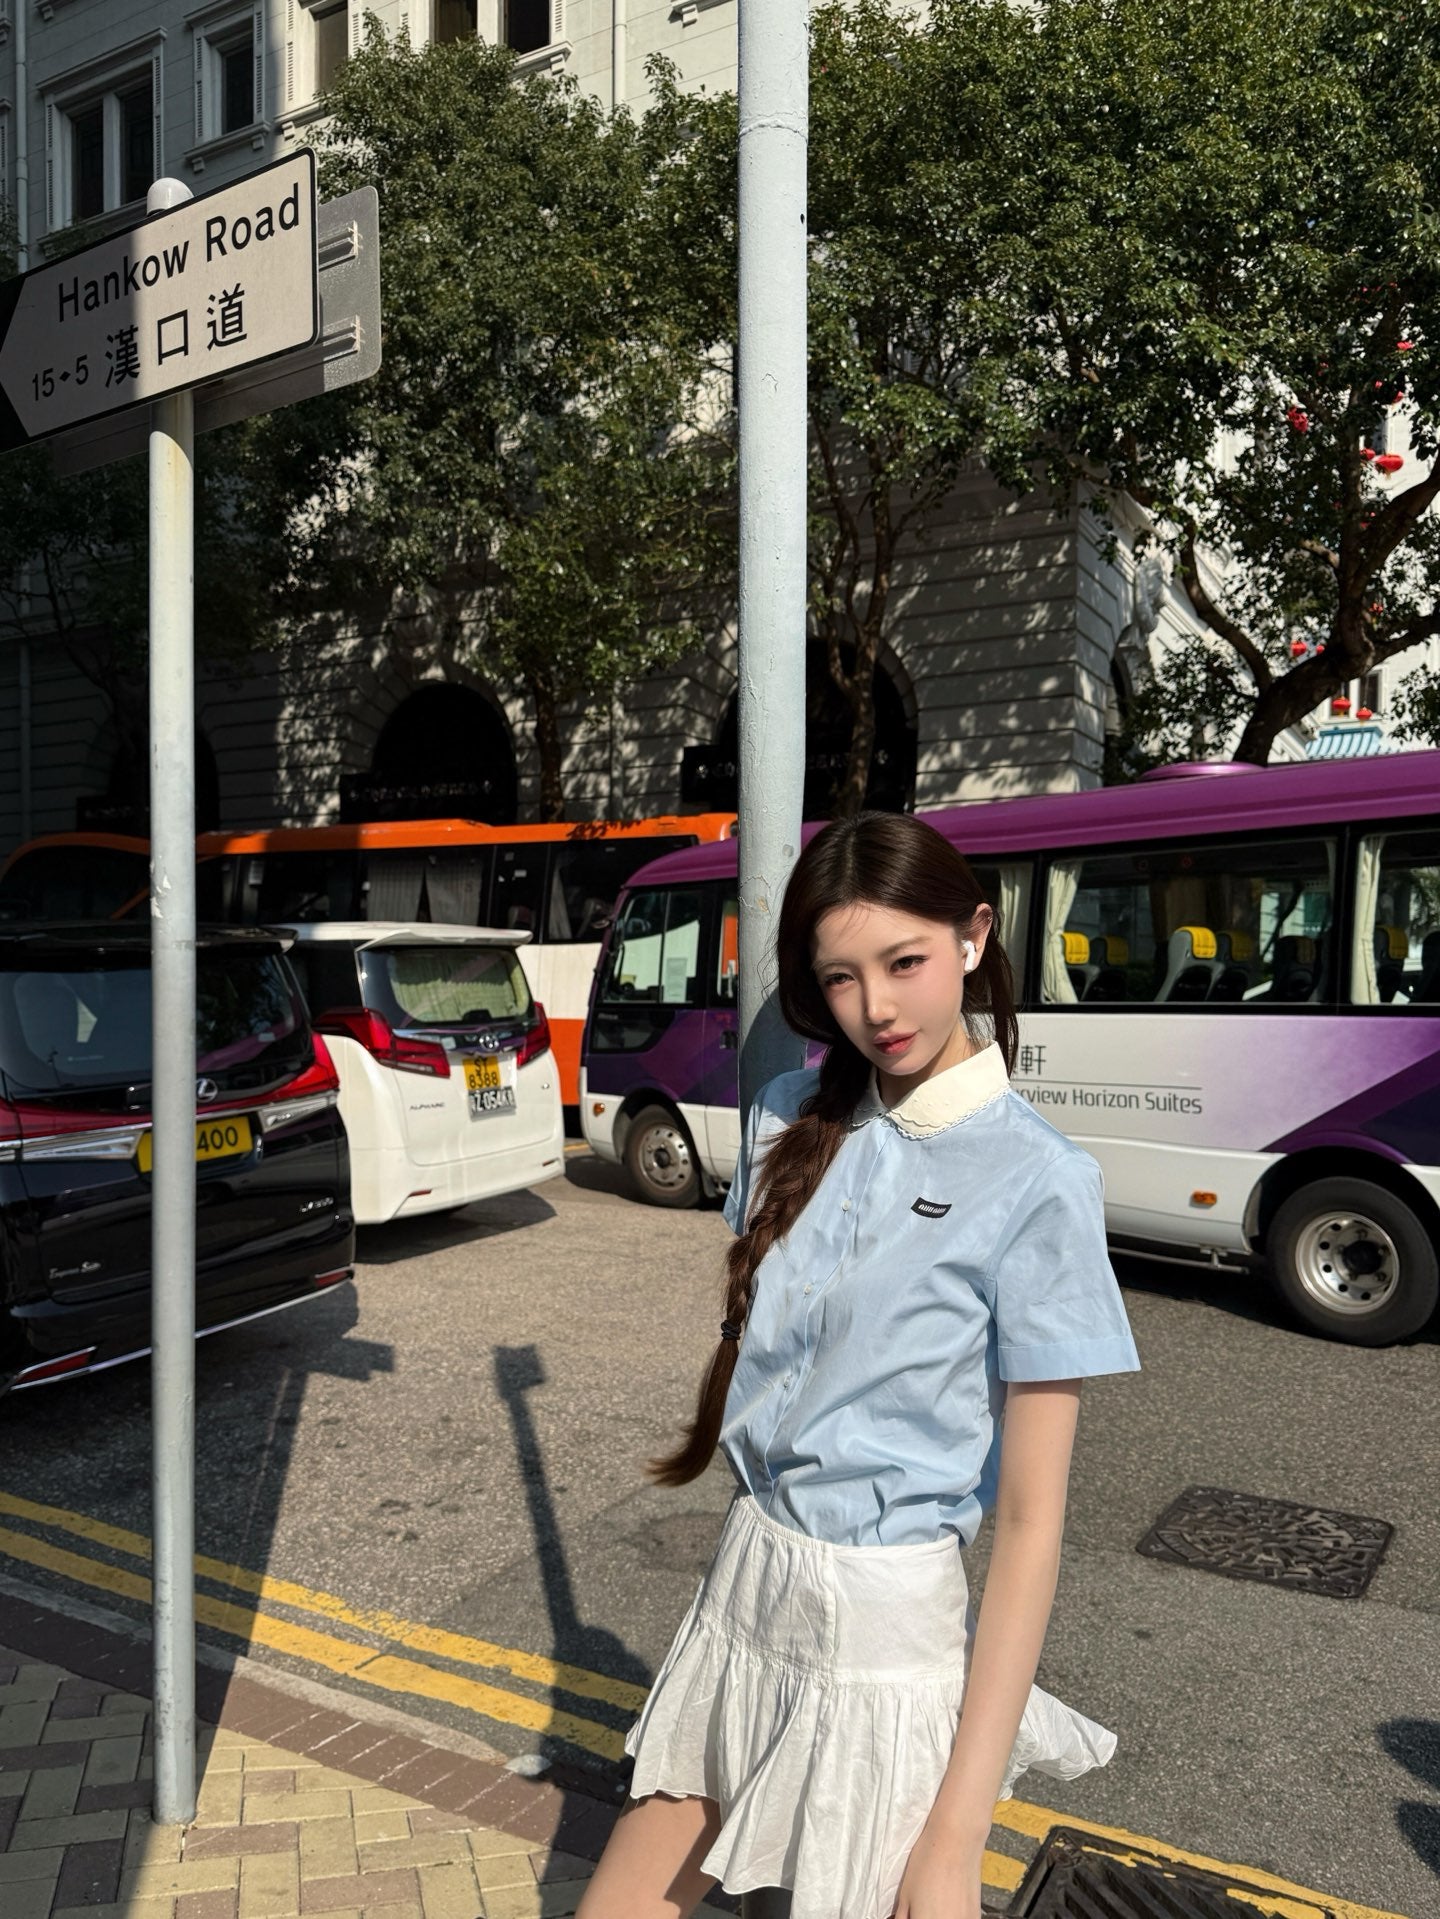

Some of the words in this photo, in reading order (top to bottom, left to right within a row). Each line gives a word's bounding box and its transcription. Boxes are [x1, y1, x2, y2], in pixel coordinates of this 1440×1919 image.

[58, 240, 190, 323] Hankow
[206, 182, 300, 262] Road
[104, 283, 247, 388] 漢口道
[1013, 1044, 1047, 1075] 軒
[1015, 1086, 1067, 1105] rview
[1072, 1088, 1140, 1109] Horizon
[1145, 1092, 1203, 1114] Suites
[197, 1126, 238, 1152] 400
